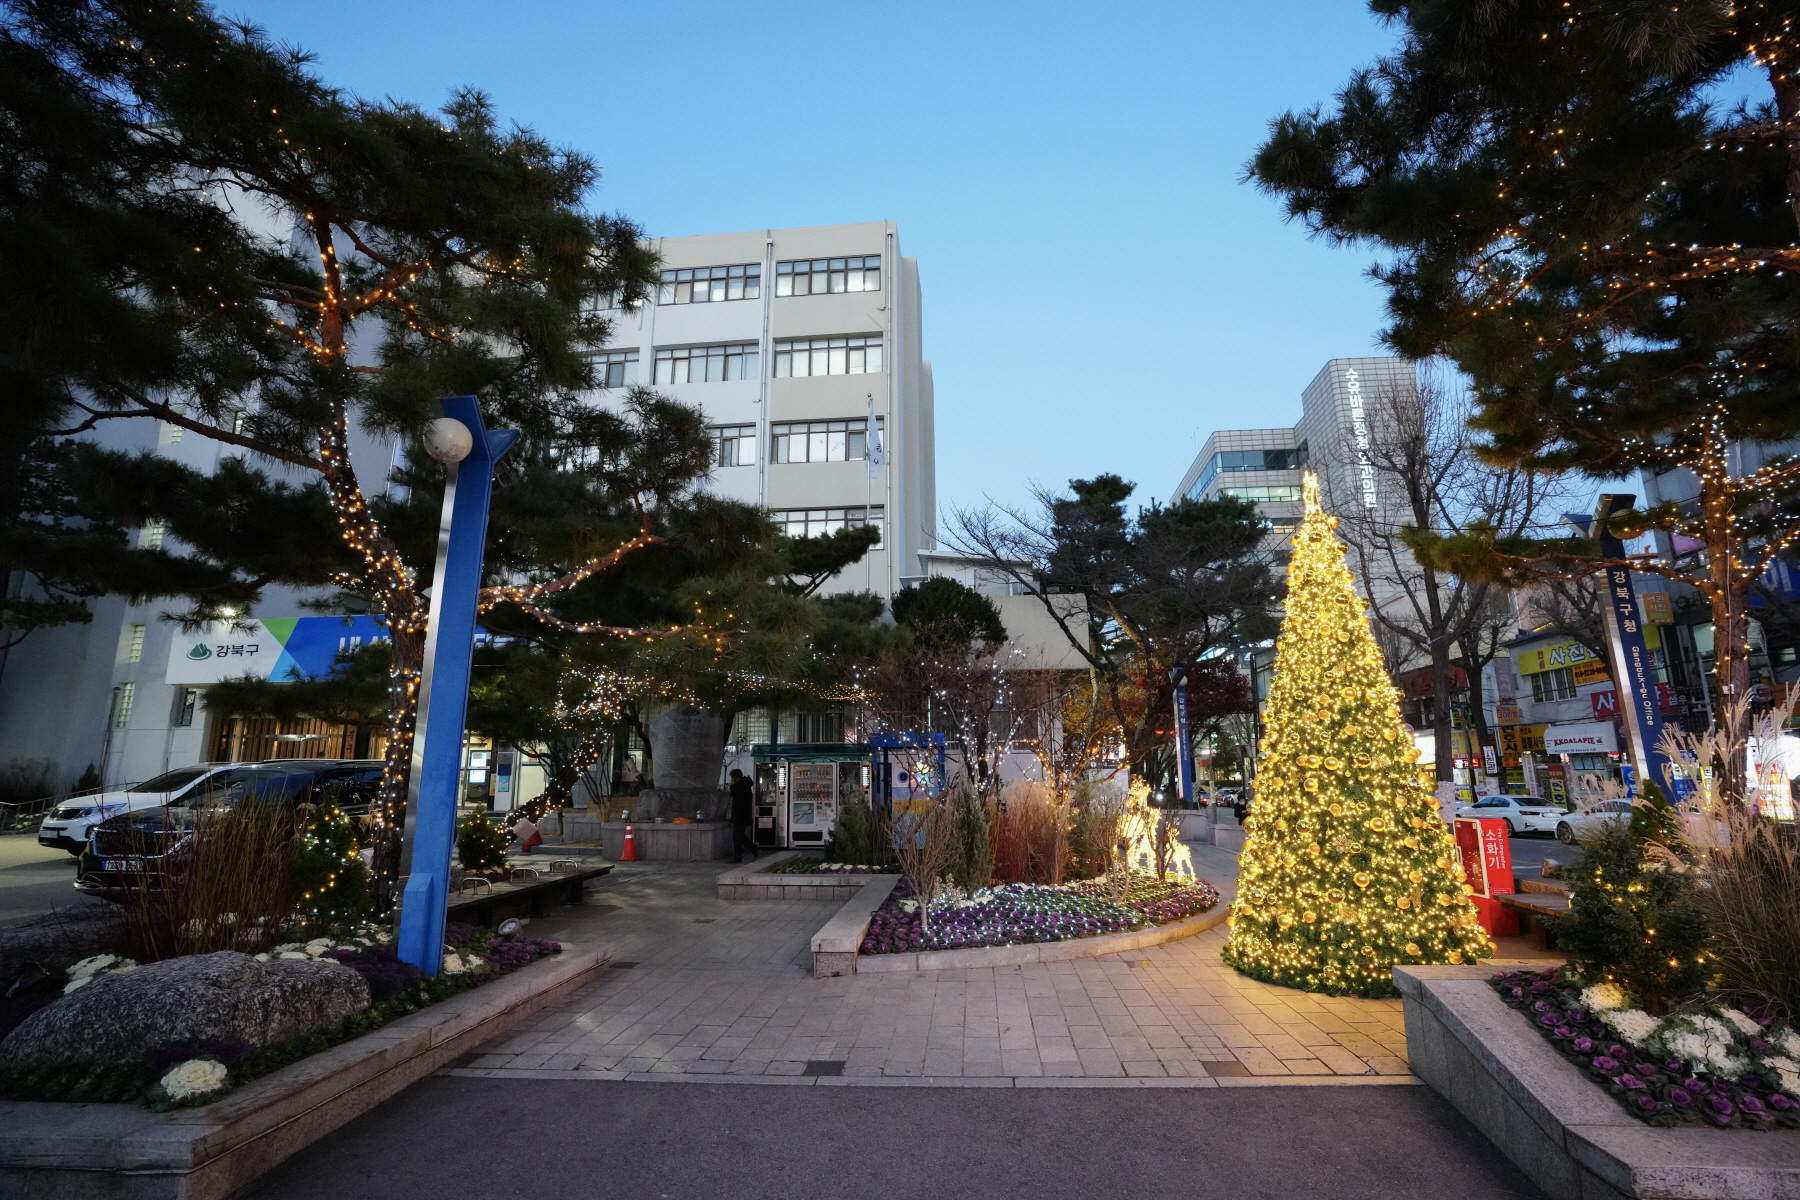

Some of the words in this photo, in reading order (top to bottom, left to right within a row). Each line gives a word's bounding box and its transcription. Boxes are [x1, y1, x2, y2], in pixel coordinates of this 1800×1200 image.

[1613, 571, 1637, 633] 강북구청
[1649, 604, 1667, 612] 사진
[215, 643, 260, 658] 강북구
[1549, 643, 1603, 666] 사진
[1632, 646, 1648, 699] Gangbuk-gu
[1643, 700, 1654, 726] Office
[1554, 737, 1596, 747] KKOALAPIE
[1485, 829, 1500, 869] 소화기
